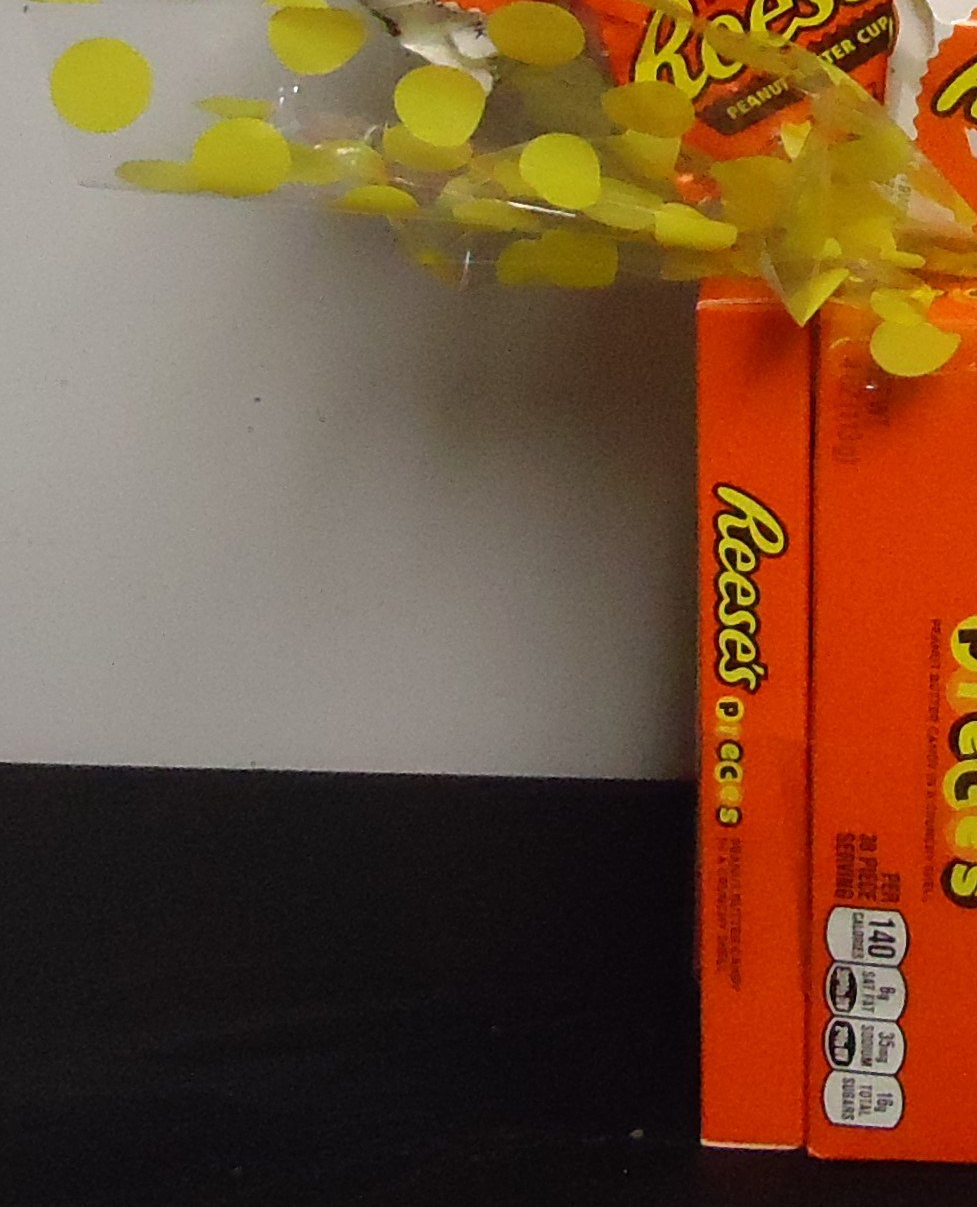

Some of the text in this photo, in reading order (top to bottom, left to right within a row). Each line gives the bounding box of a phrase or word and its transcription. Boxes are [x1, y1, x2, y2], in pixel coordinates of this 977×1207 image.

[856, 15, 890, 44] CUP
[712, 481, 789, 695] Reese's
[834, 832, 856, 900] SERVING
[867, 917, 896, 960] 140
[860, 970, 876, 1015] SAT FAT
[841, 1076, 856, 1121] SUGARS
[858, 1084, 873, 1117] TOTAL
